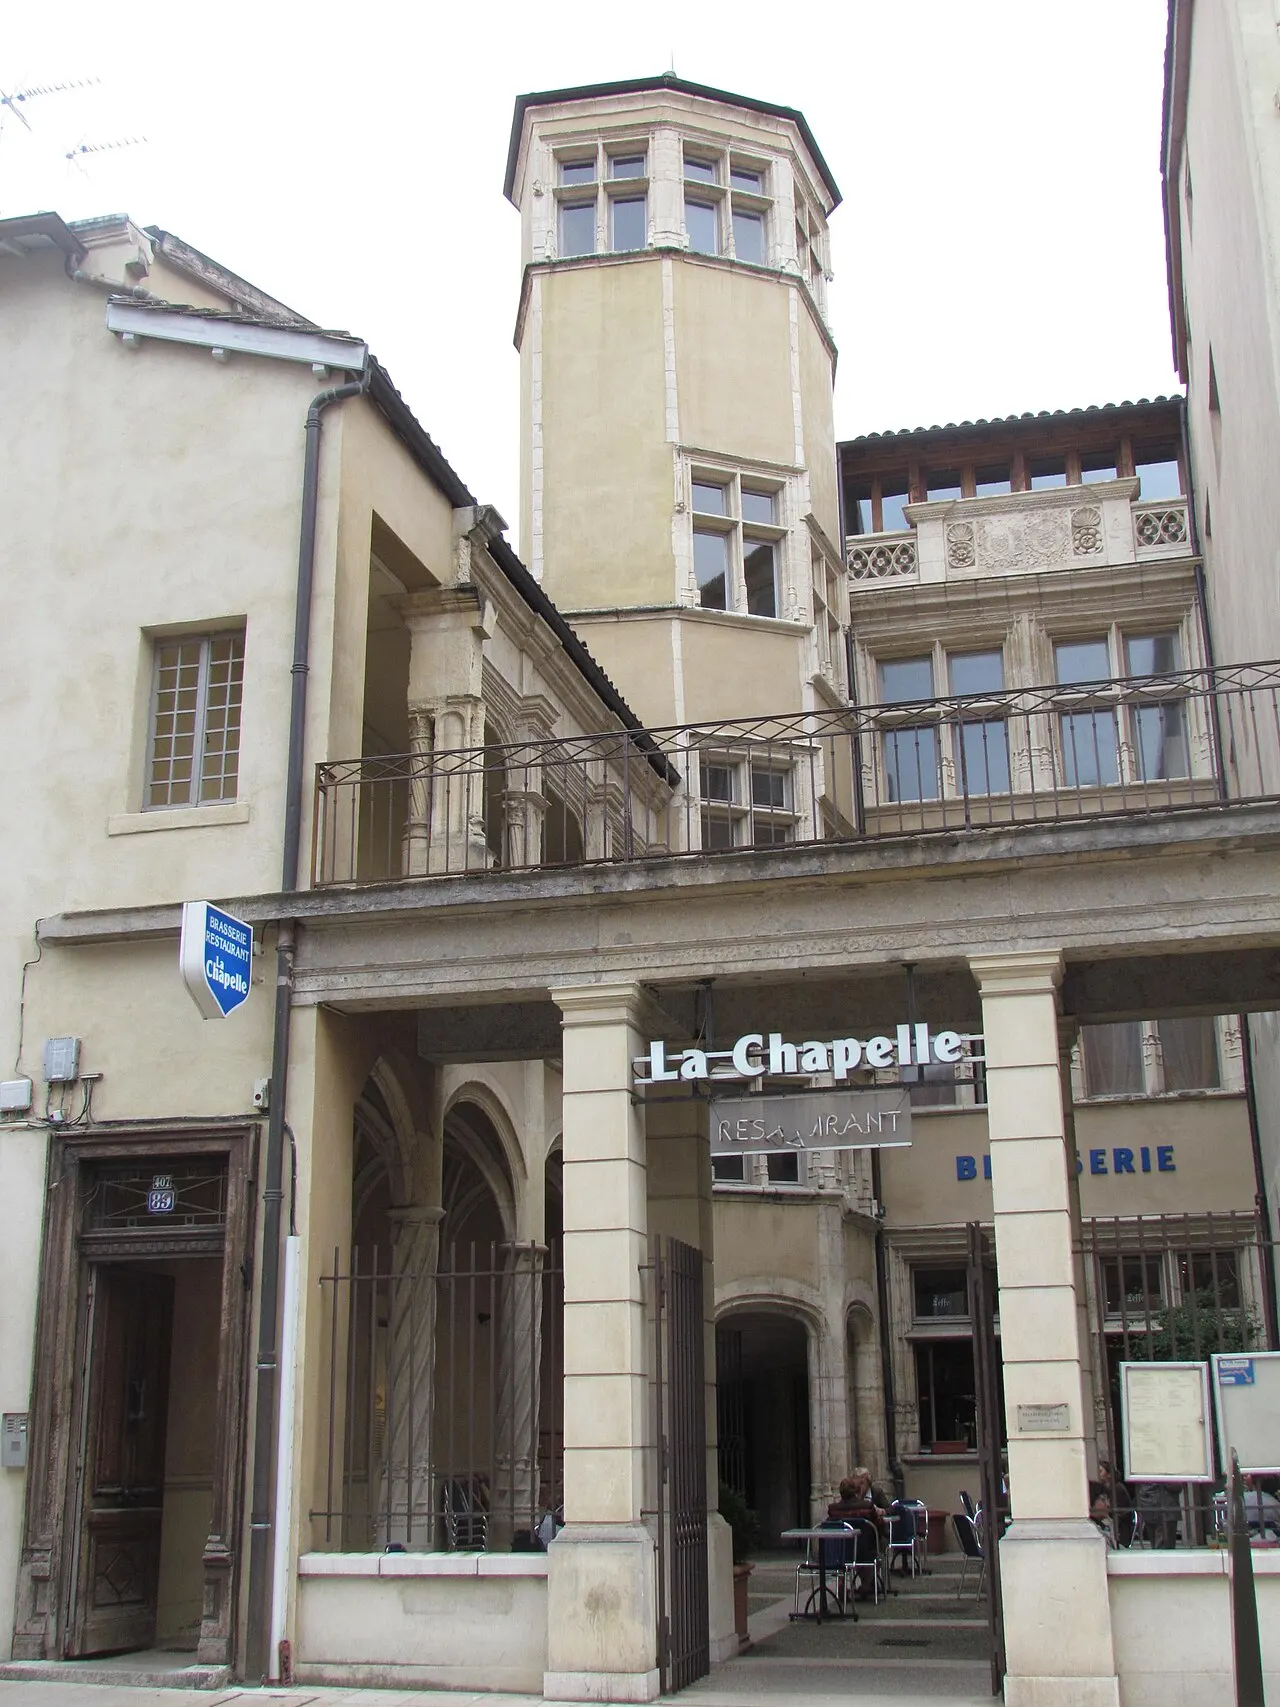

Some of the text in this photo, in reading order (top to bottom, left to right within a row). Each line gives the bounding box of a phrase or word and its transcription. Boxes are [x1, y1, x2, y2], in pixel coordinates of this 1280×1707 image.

[209, 916, 247, 945] BRASSERIE
[206, 931, 249, 962] RESTAURANT
[206, 959, 247, 994] Chapelle
[216, 955, 224, 970] La
[650, 1022, 963, 1082] La Chapelle
[956, 1145, 1176, 1181] BERIE
[155, 1177, 171, 1188] 407
[152, 1193, 171, 1208] 89
